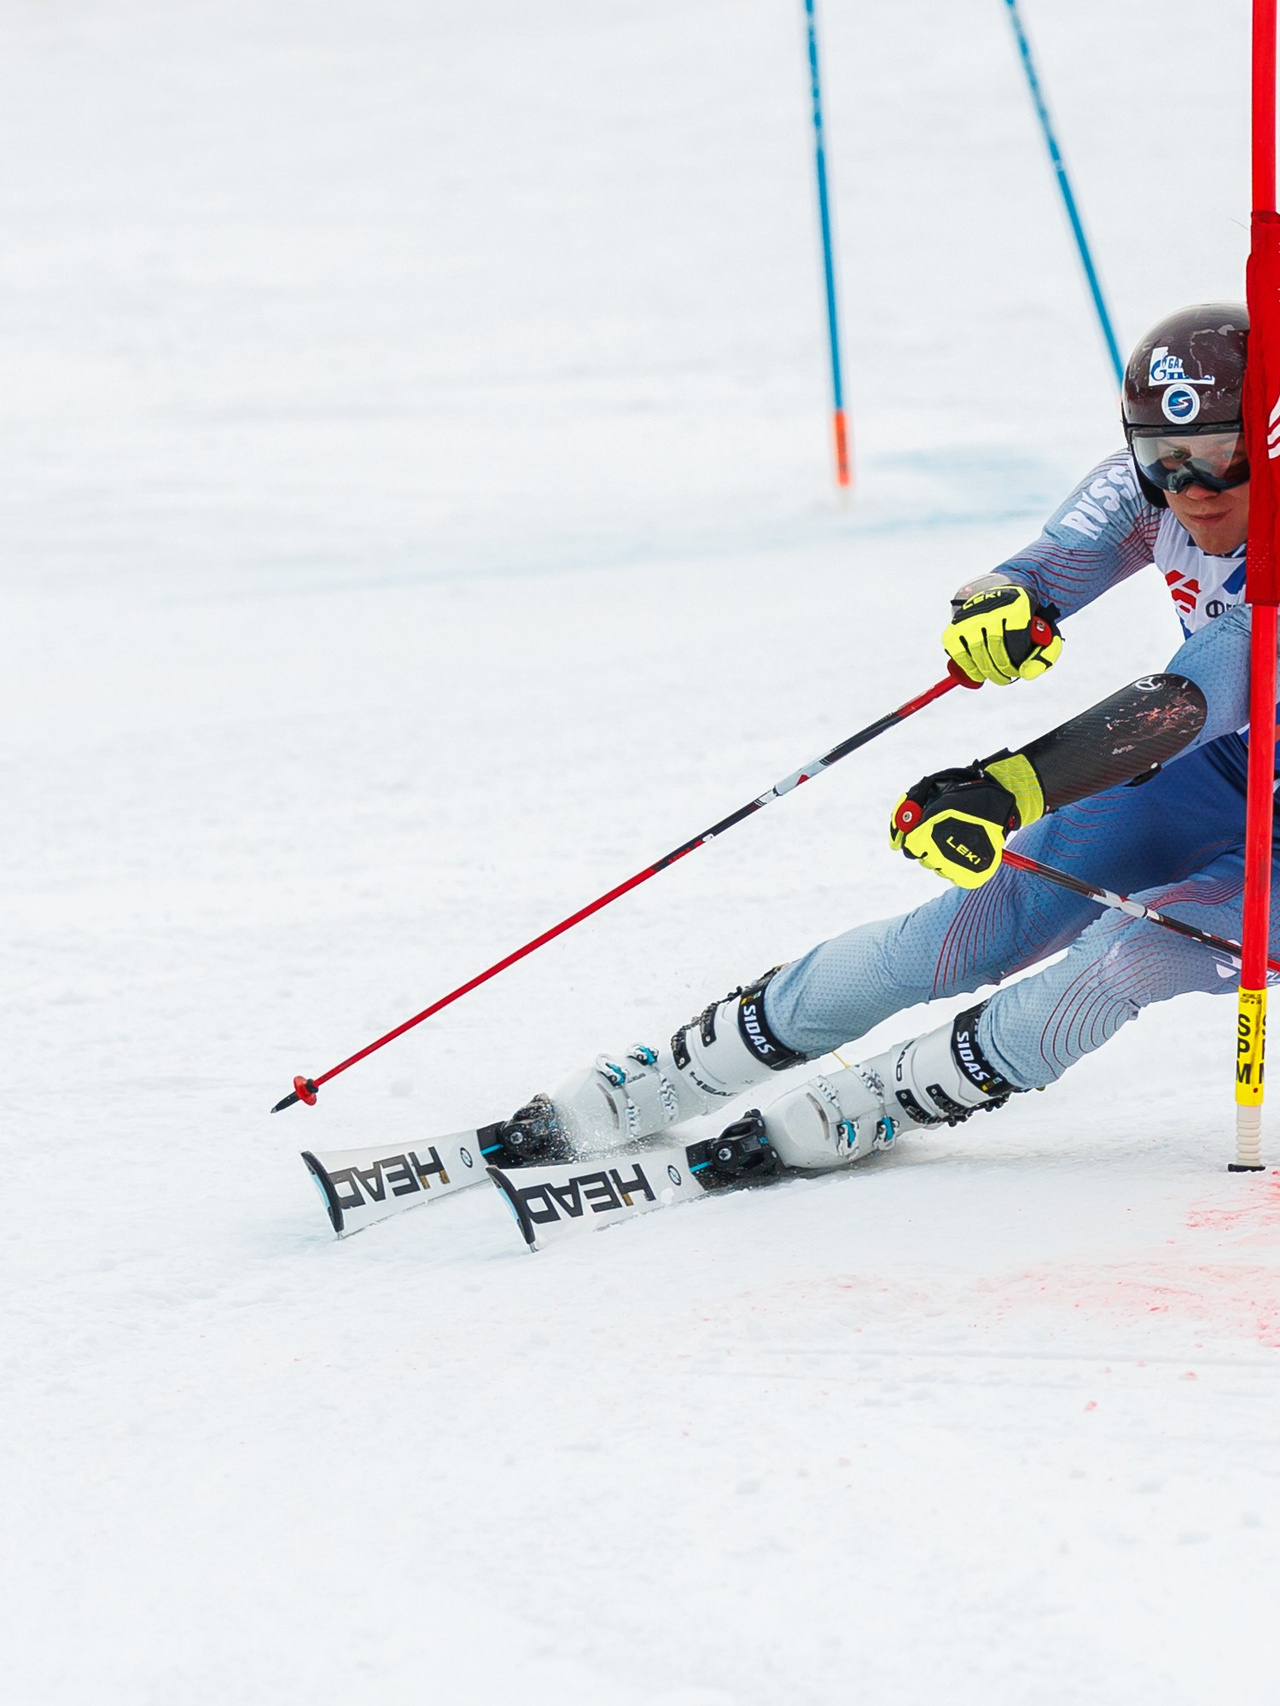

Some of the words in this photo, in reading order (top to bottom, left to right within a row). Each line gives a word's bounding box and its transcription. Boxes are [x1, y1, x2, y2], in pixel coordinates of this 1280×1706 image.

[945, 836, 981, 865] LEKI
[743, 1004, 776, 1054] SIDAS
[957, 1031, 991, 1081] SIDAS
[326, 1146, 451, 1210] HEAD
[517, 1163, 657, 1225] HEAD
